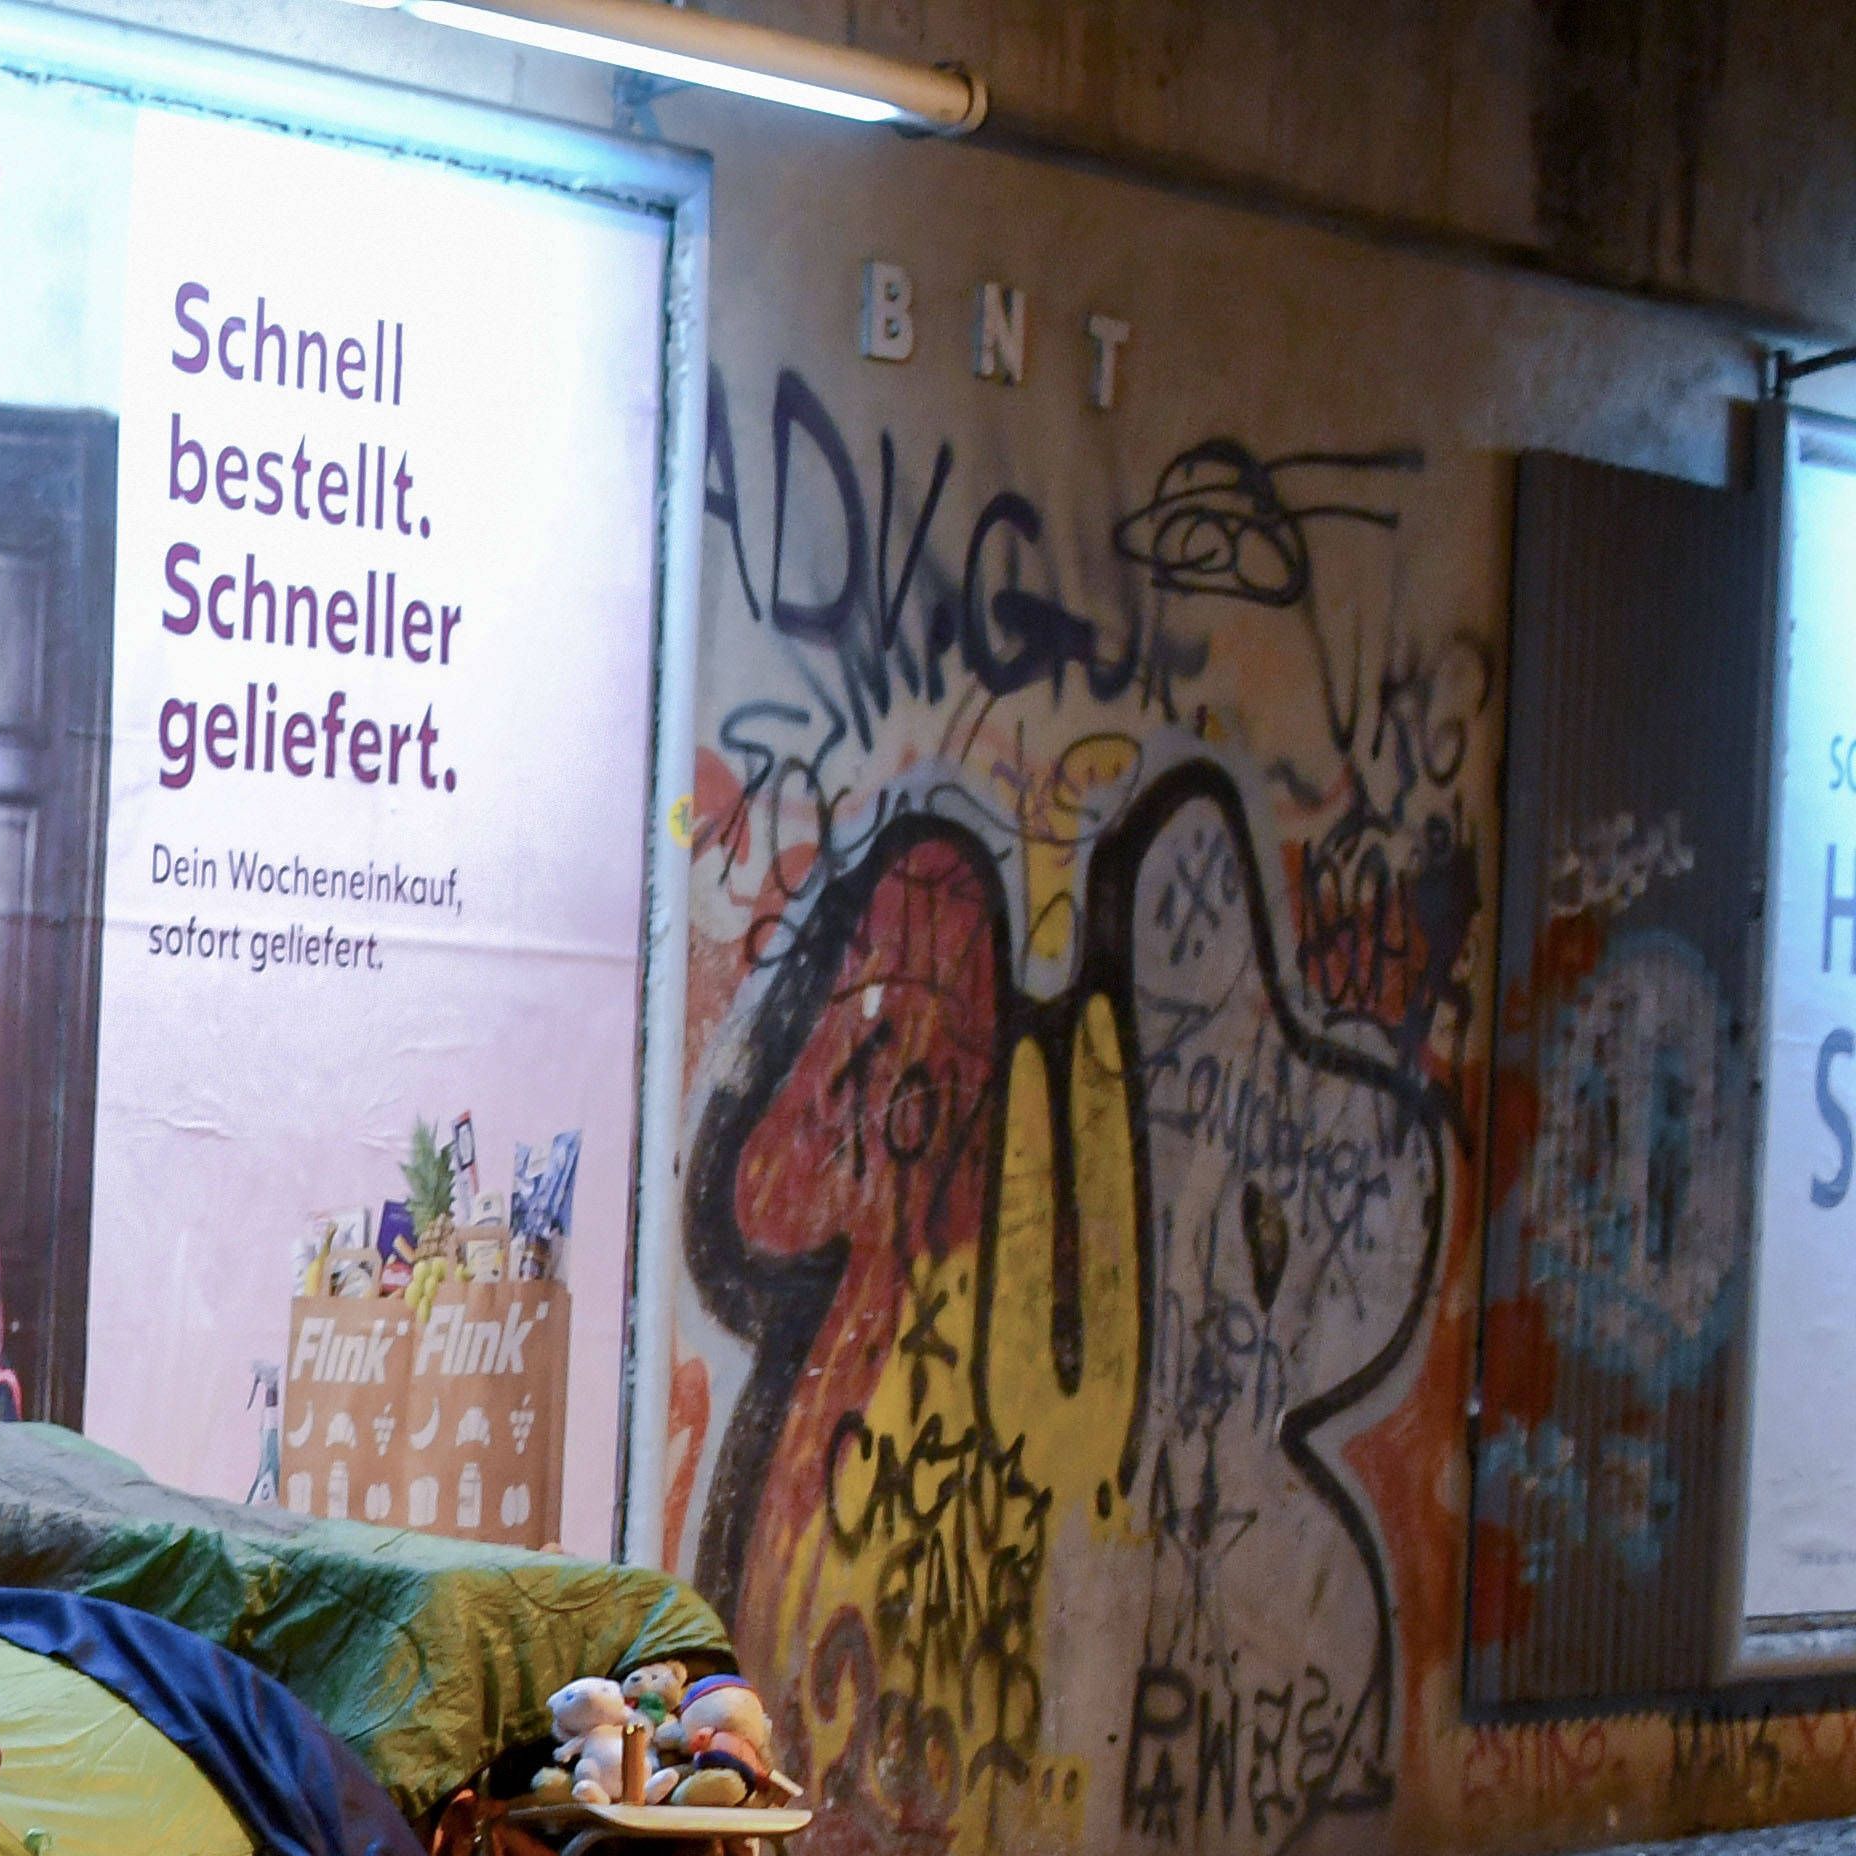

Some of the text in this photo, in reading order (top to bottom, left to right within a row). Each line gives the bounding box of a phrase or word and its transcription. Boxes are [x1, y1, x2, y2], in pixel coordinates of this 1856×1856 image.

[171, 281, 403, 406] Schnell
[169, 412, 431, 539] bestellt.
[161, 541, 462, 665] Schneller
[158, 681, 456, 794] geliefert.
[152, 843, 463, 916] Dein Wocheneinkauf,
[149, 915, 383, 972] sofort geliefert.
[292, 1316, 410, 1385] Flink
[412, 1302, 550, 1377] Flink
